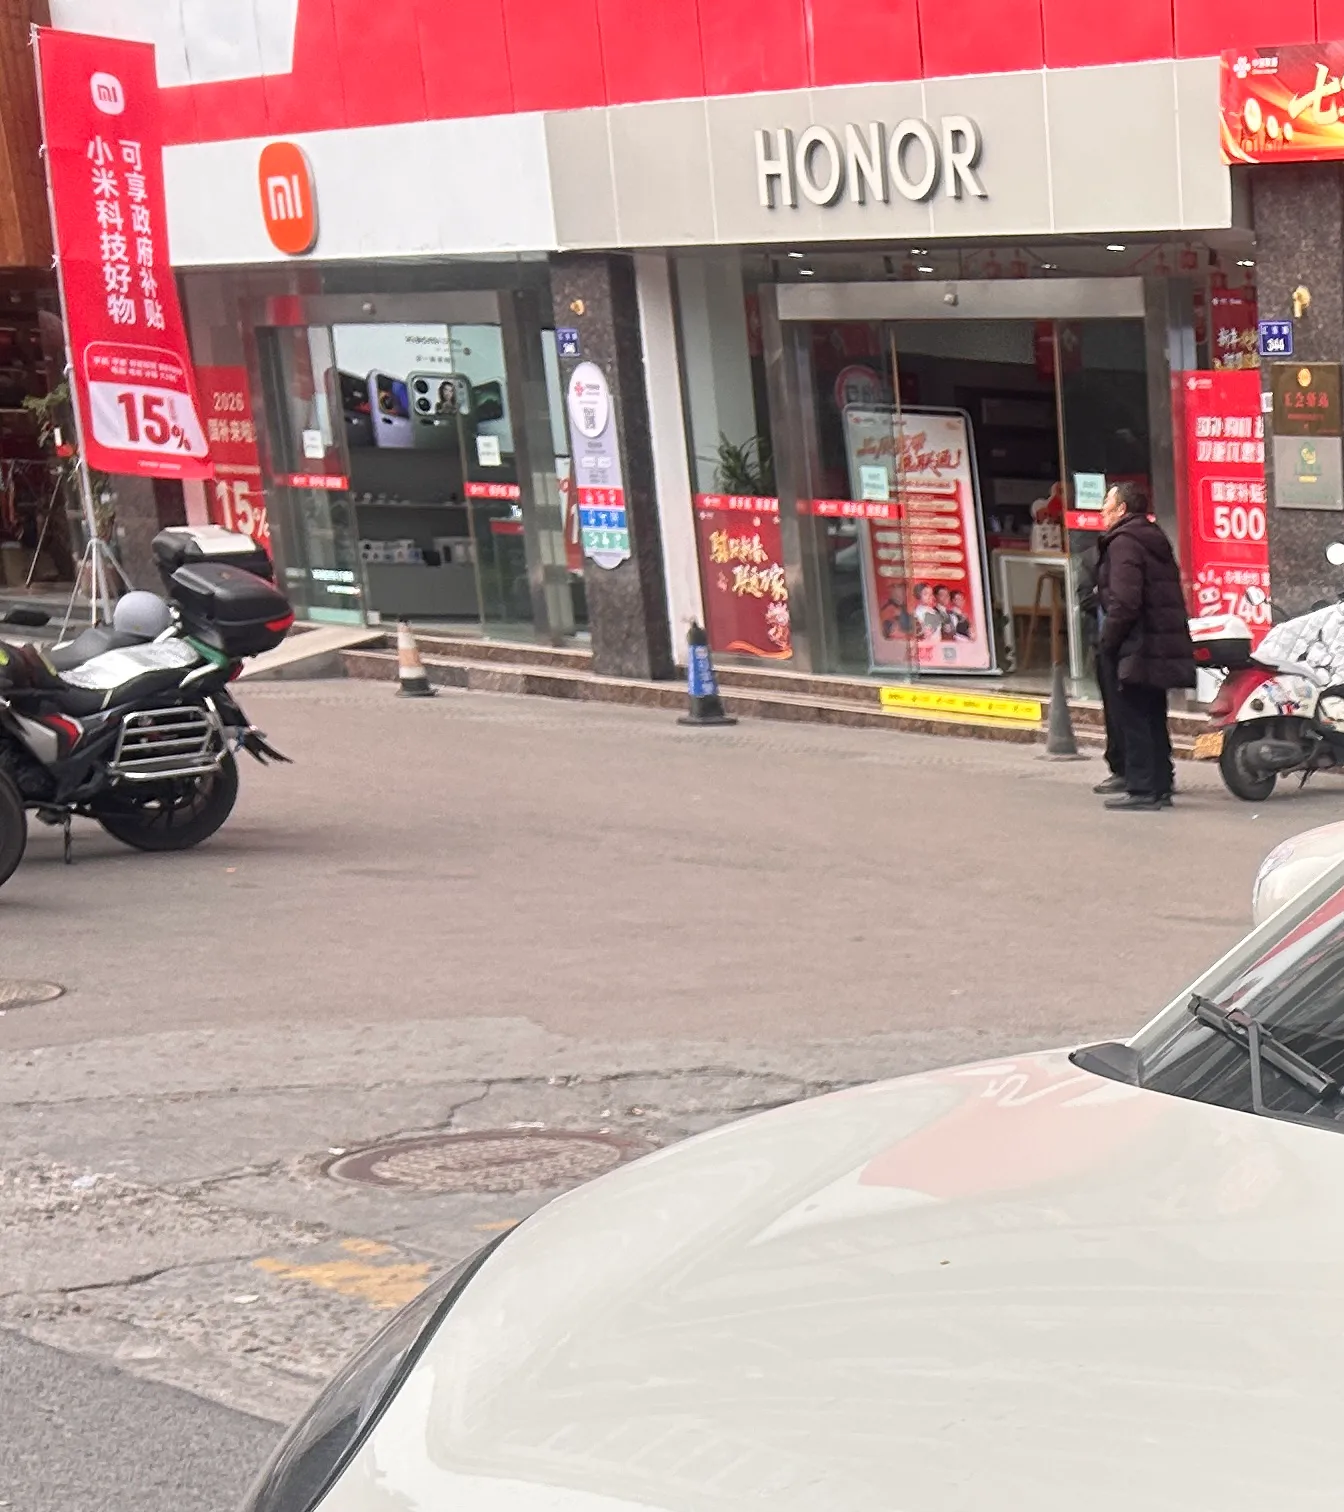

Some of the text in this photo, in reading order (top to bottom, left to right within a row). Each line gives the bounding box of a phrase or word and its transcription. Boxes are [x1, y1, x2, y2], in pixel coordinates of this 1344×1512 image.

[754, 115, 988, 208] HONOR
[87, 135, 136, 326] 小米科技好物
[119, 139, 165, 331] 可享政府补贴
[117, 391, 192, 452] 15%
[1214, 506, 1266, 540] 500
